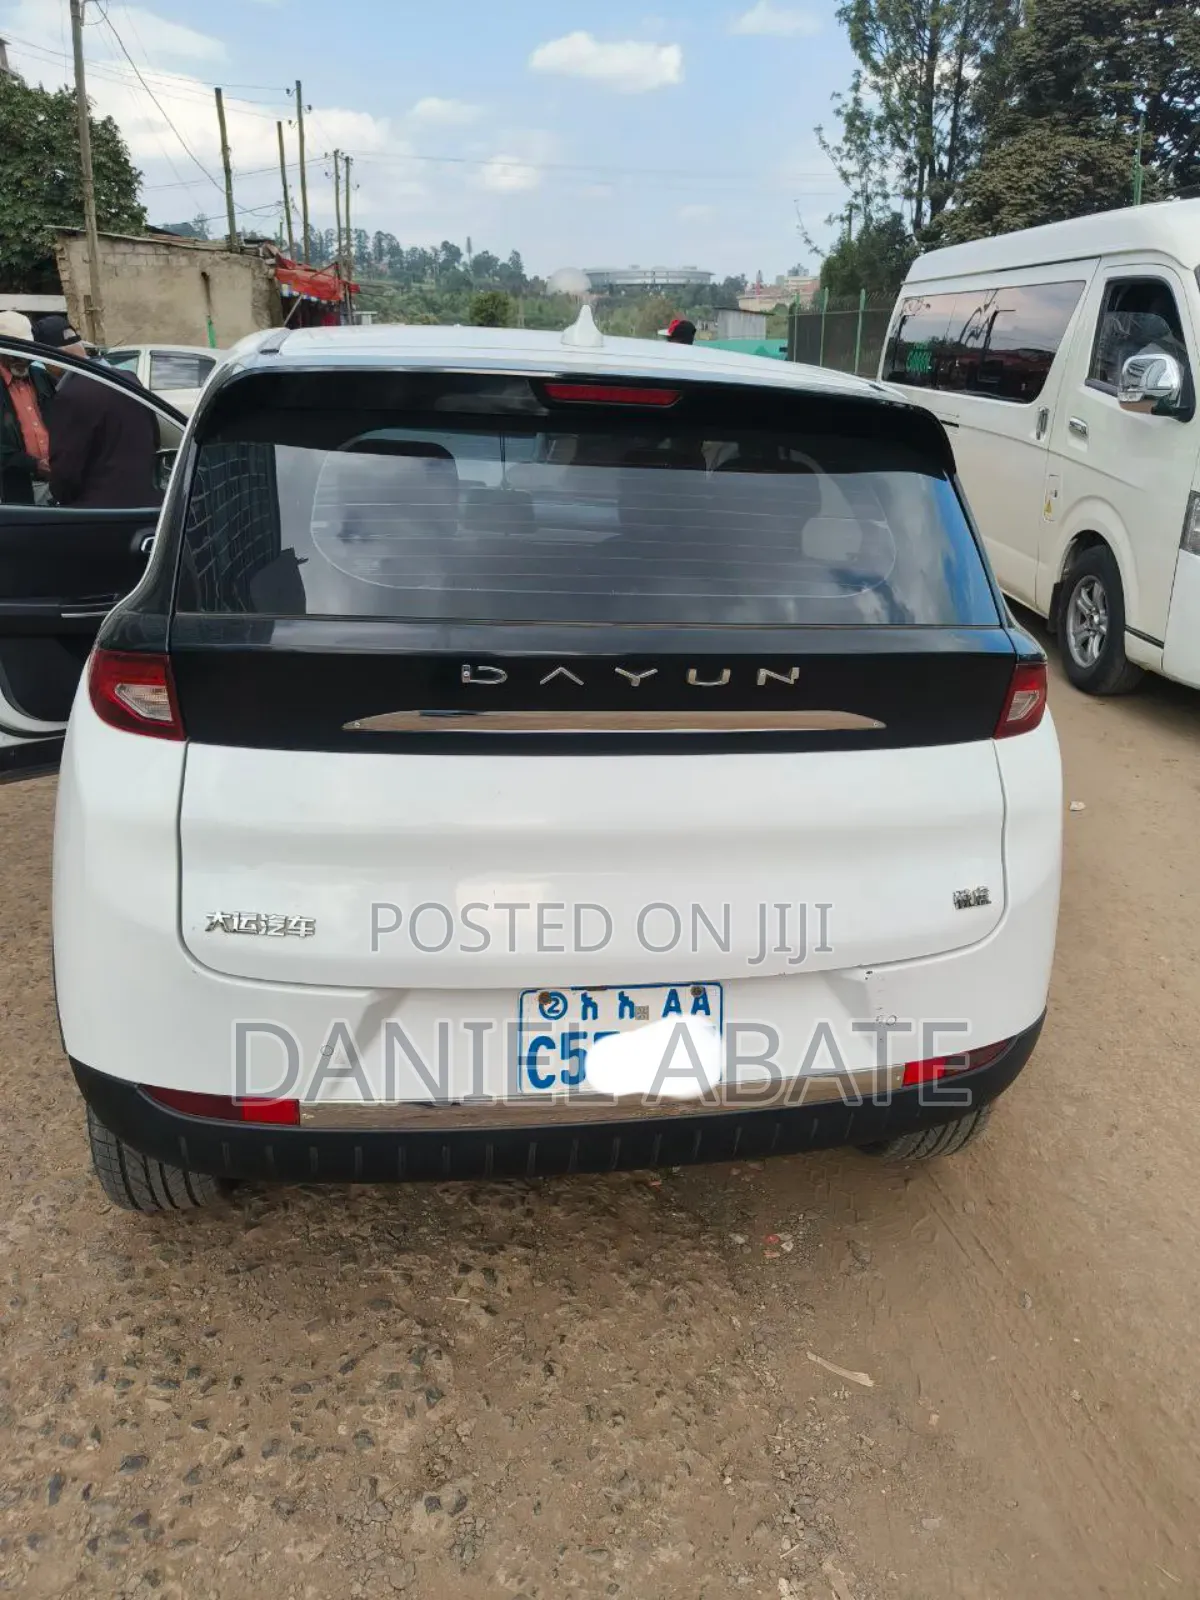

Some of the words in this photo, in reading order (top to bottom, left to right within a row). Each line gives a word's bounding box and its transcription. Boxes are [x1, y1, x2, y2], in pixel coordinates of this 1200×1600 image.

[461, 664, 800, 687] DAYUN
[205, 911, 316, 937] 大运汽车
